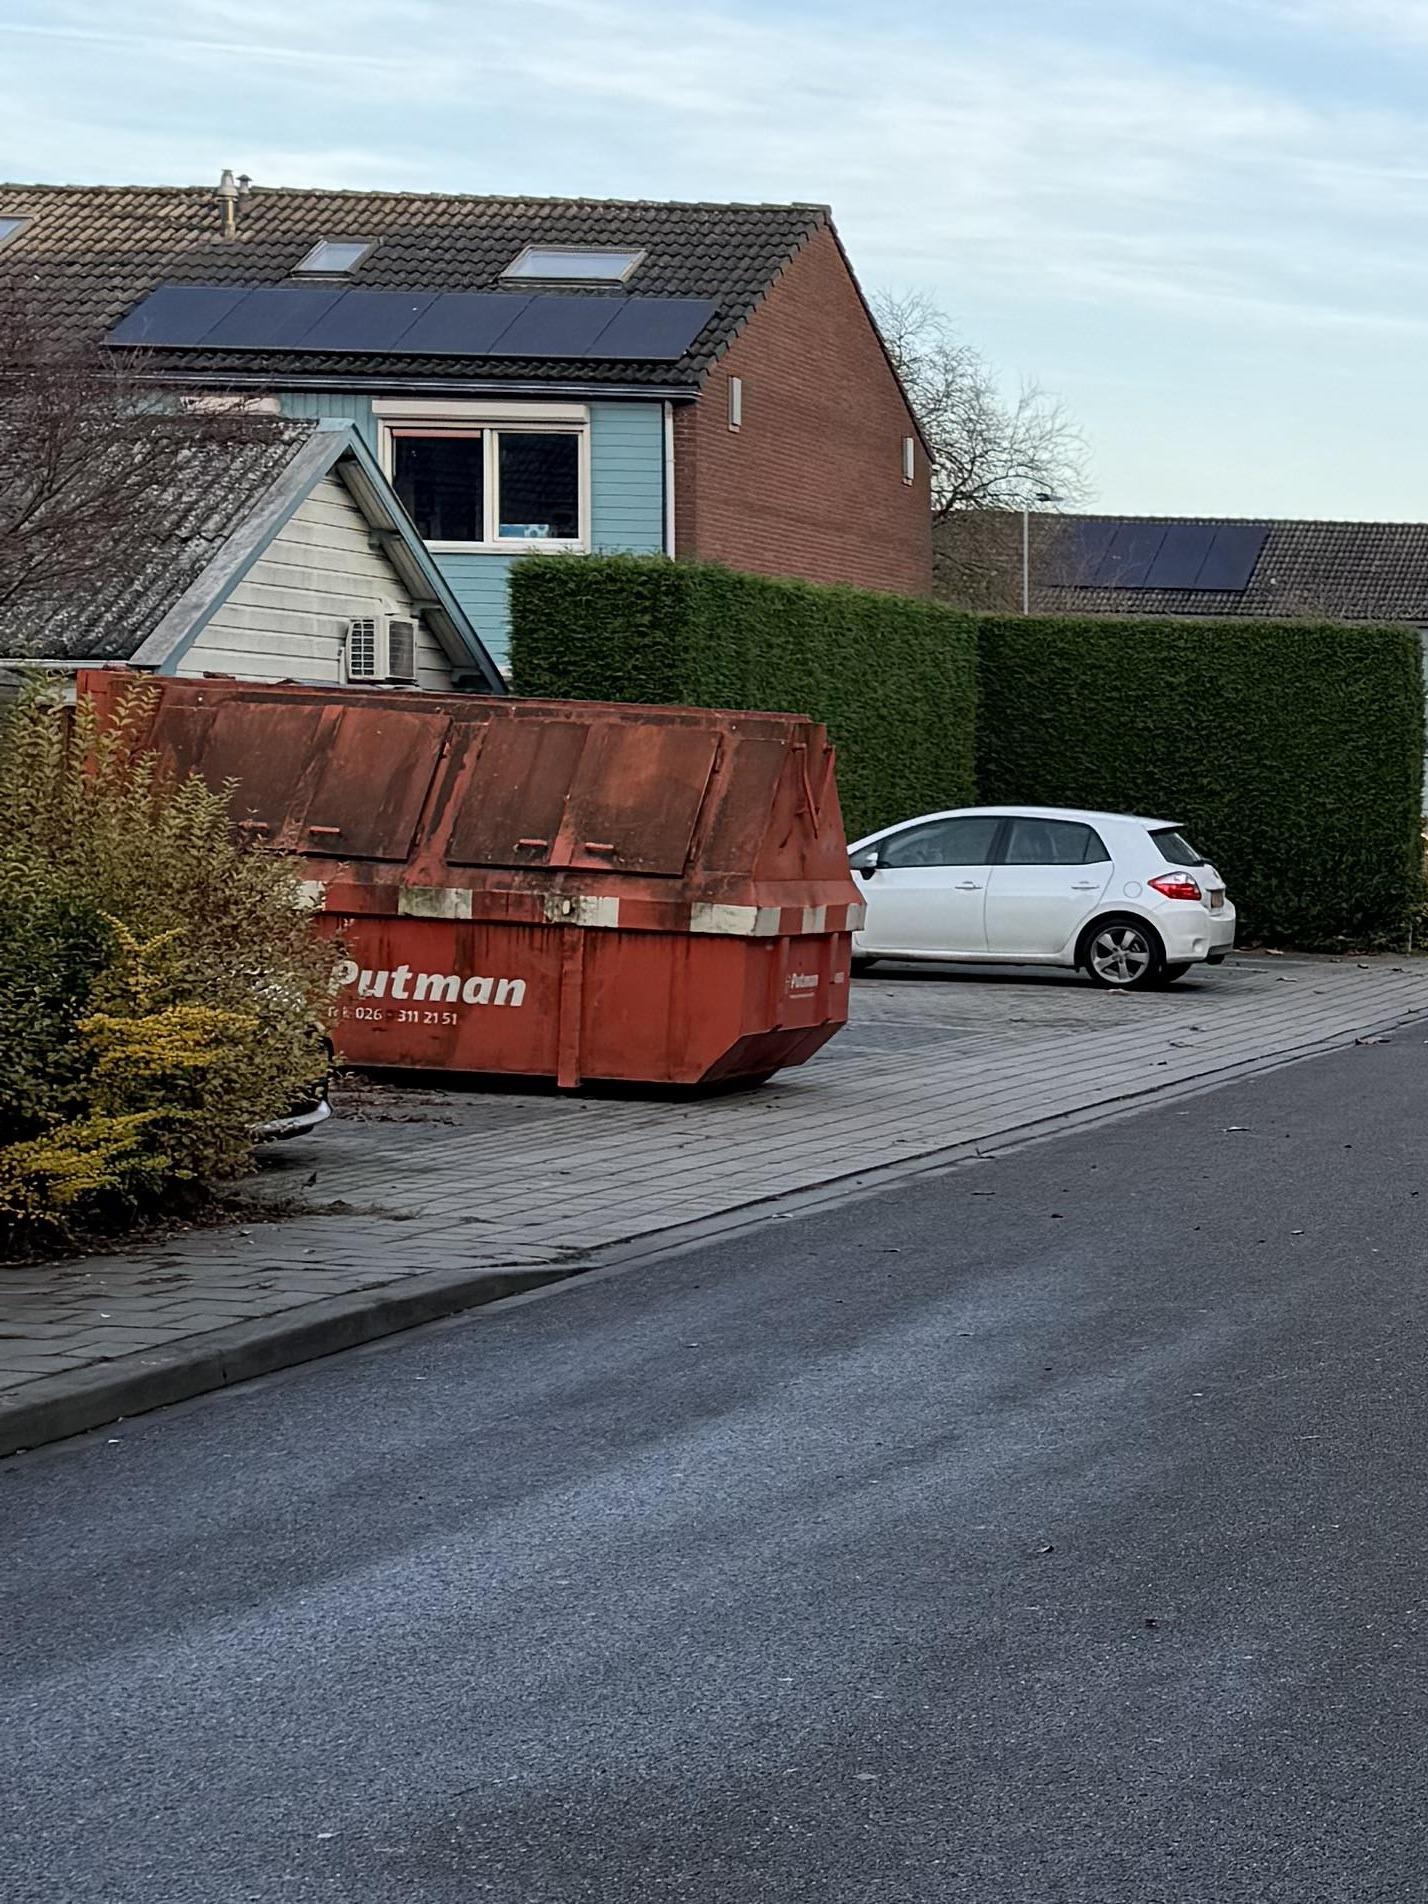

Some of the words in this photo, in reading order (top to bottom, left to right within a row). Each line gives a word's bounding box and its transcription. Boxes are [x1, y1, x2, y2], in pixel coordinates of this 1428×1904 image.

[328, 960, 527, 1007] Putman
[355, 1006, 383, 1021] 026
[397, 1009, 419, 1023] 311
